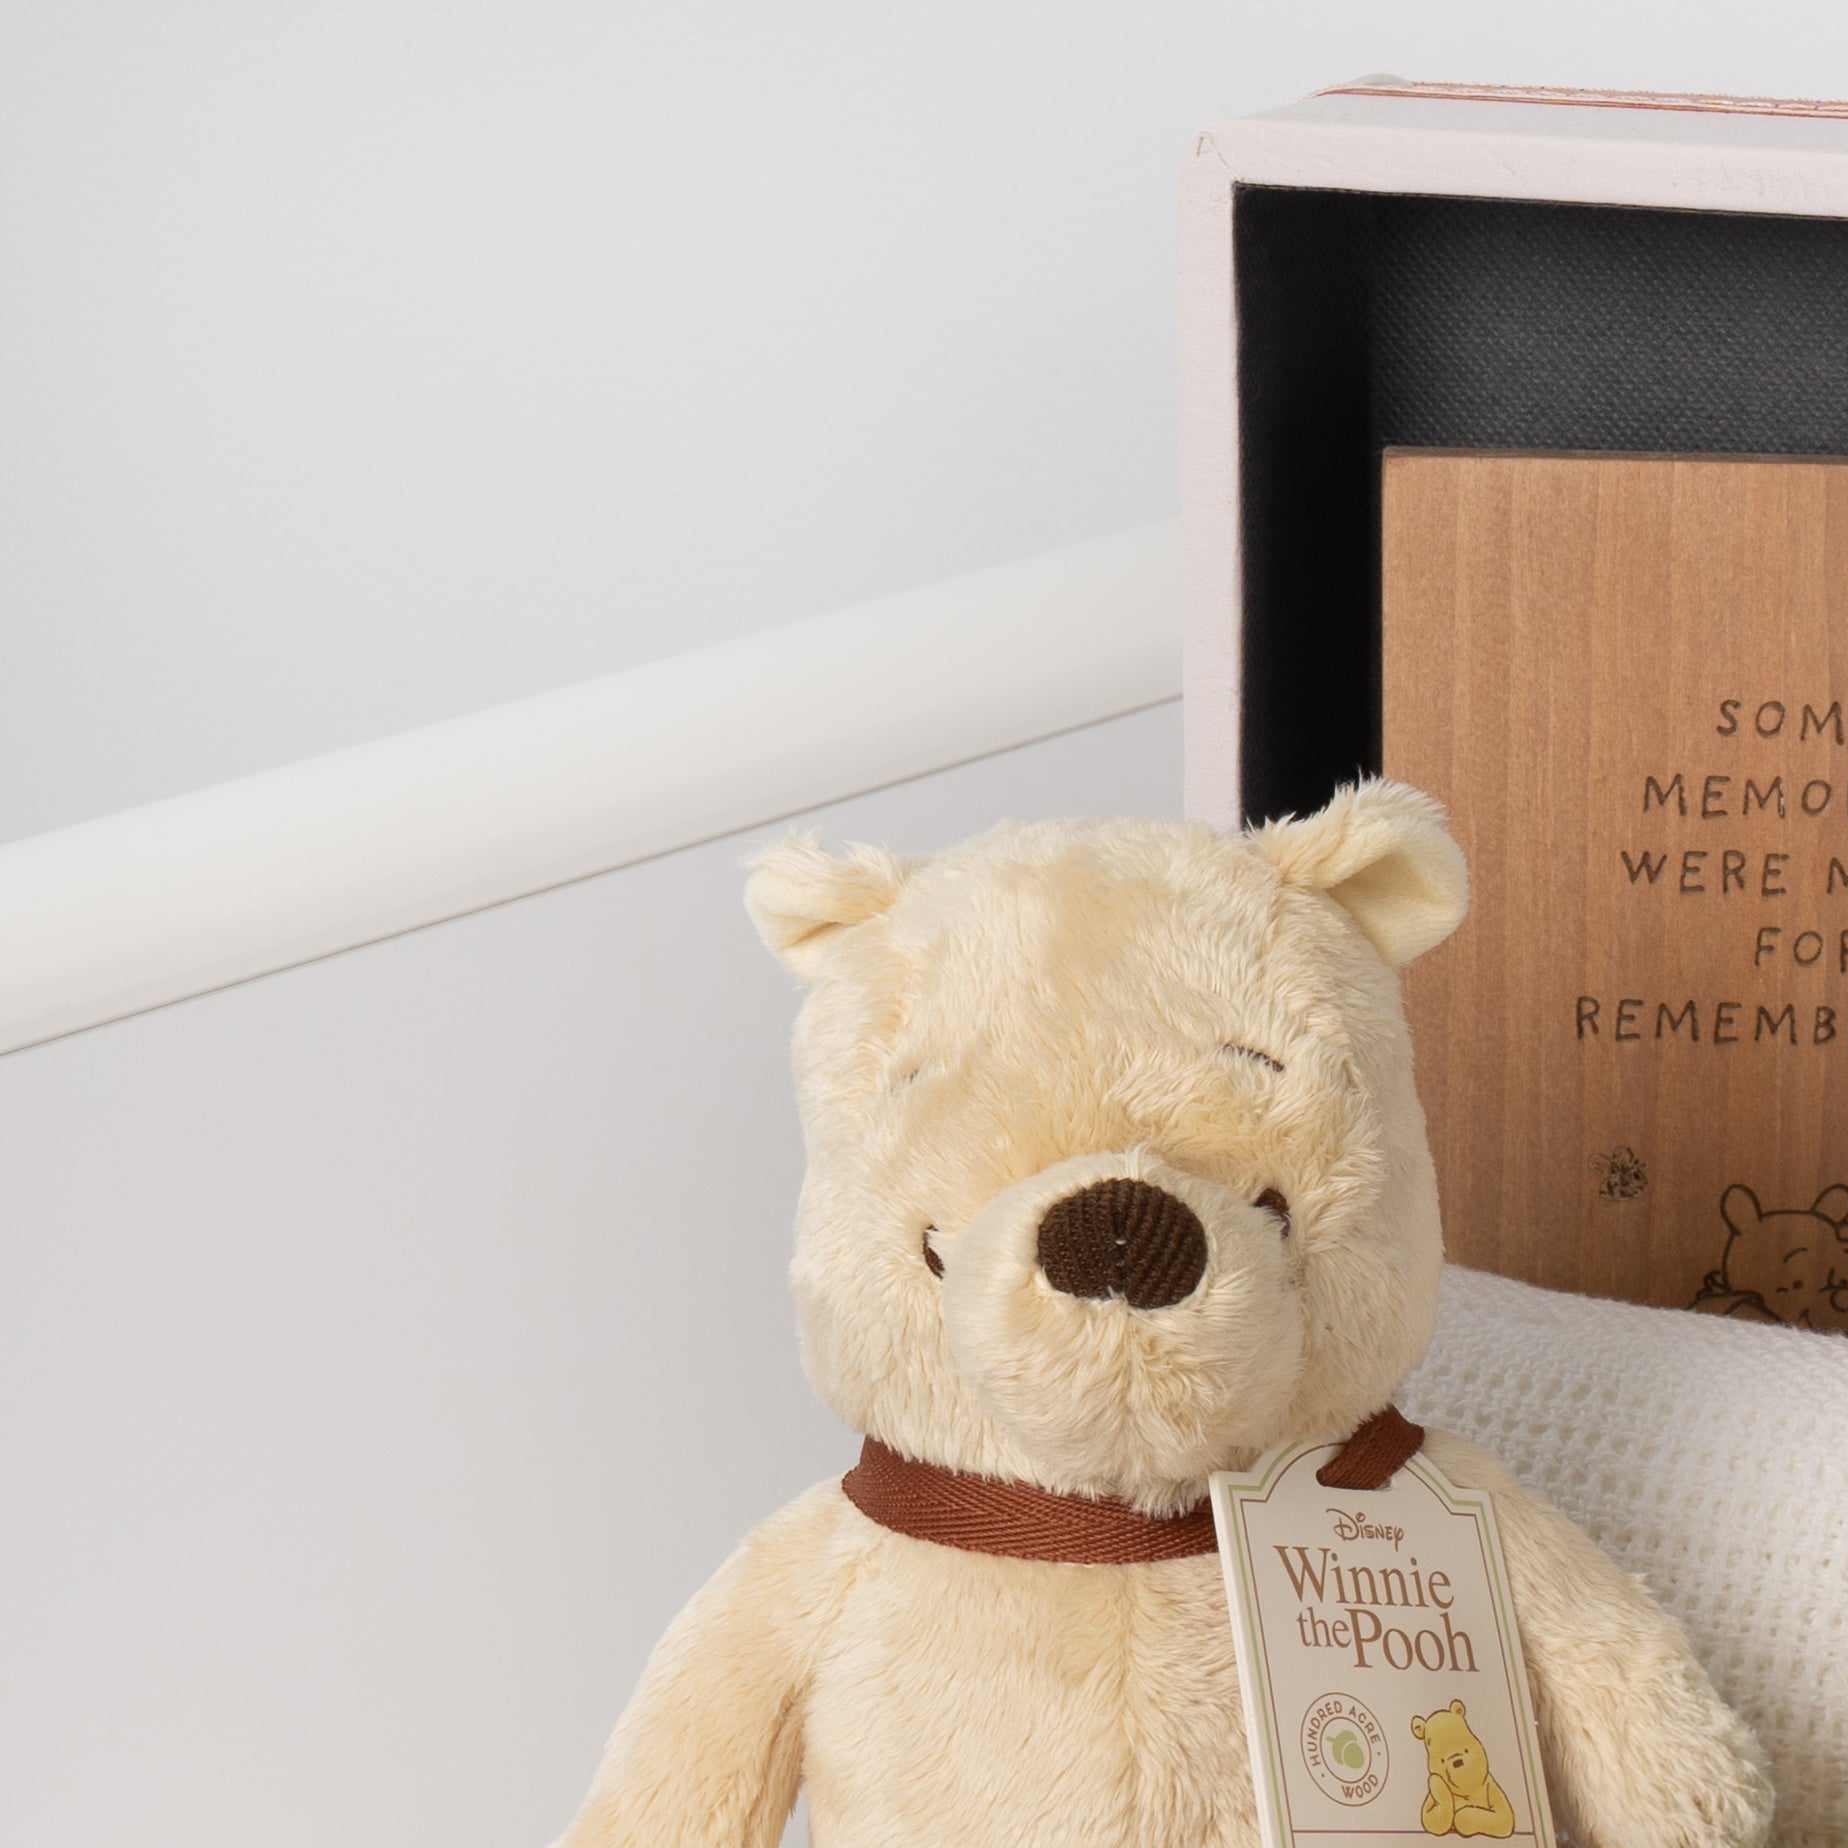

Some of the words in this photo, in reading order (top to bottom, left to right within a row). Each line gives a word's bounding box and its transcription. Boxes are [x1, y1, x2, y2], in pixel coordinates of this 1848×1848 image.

[1620, 850, 1790, 896] WERE
[1273, 1545, 1455, 1609] Winnie
[1306, 1700, 1343, 1767] HUNDRED
[1348, 1705, 1381, 1744] ACRE
[1341, 1774, 1379, 1799] WOOD
